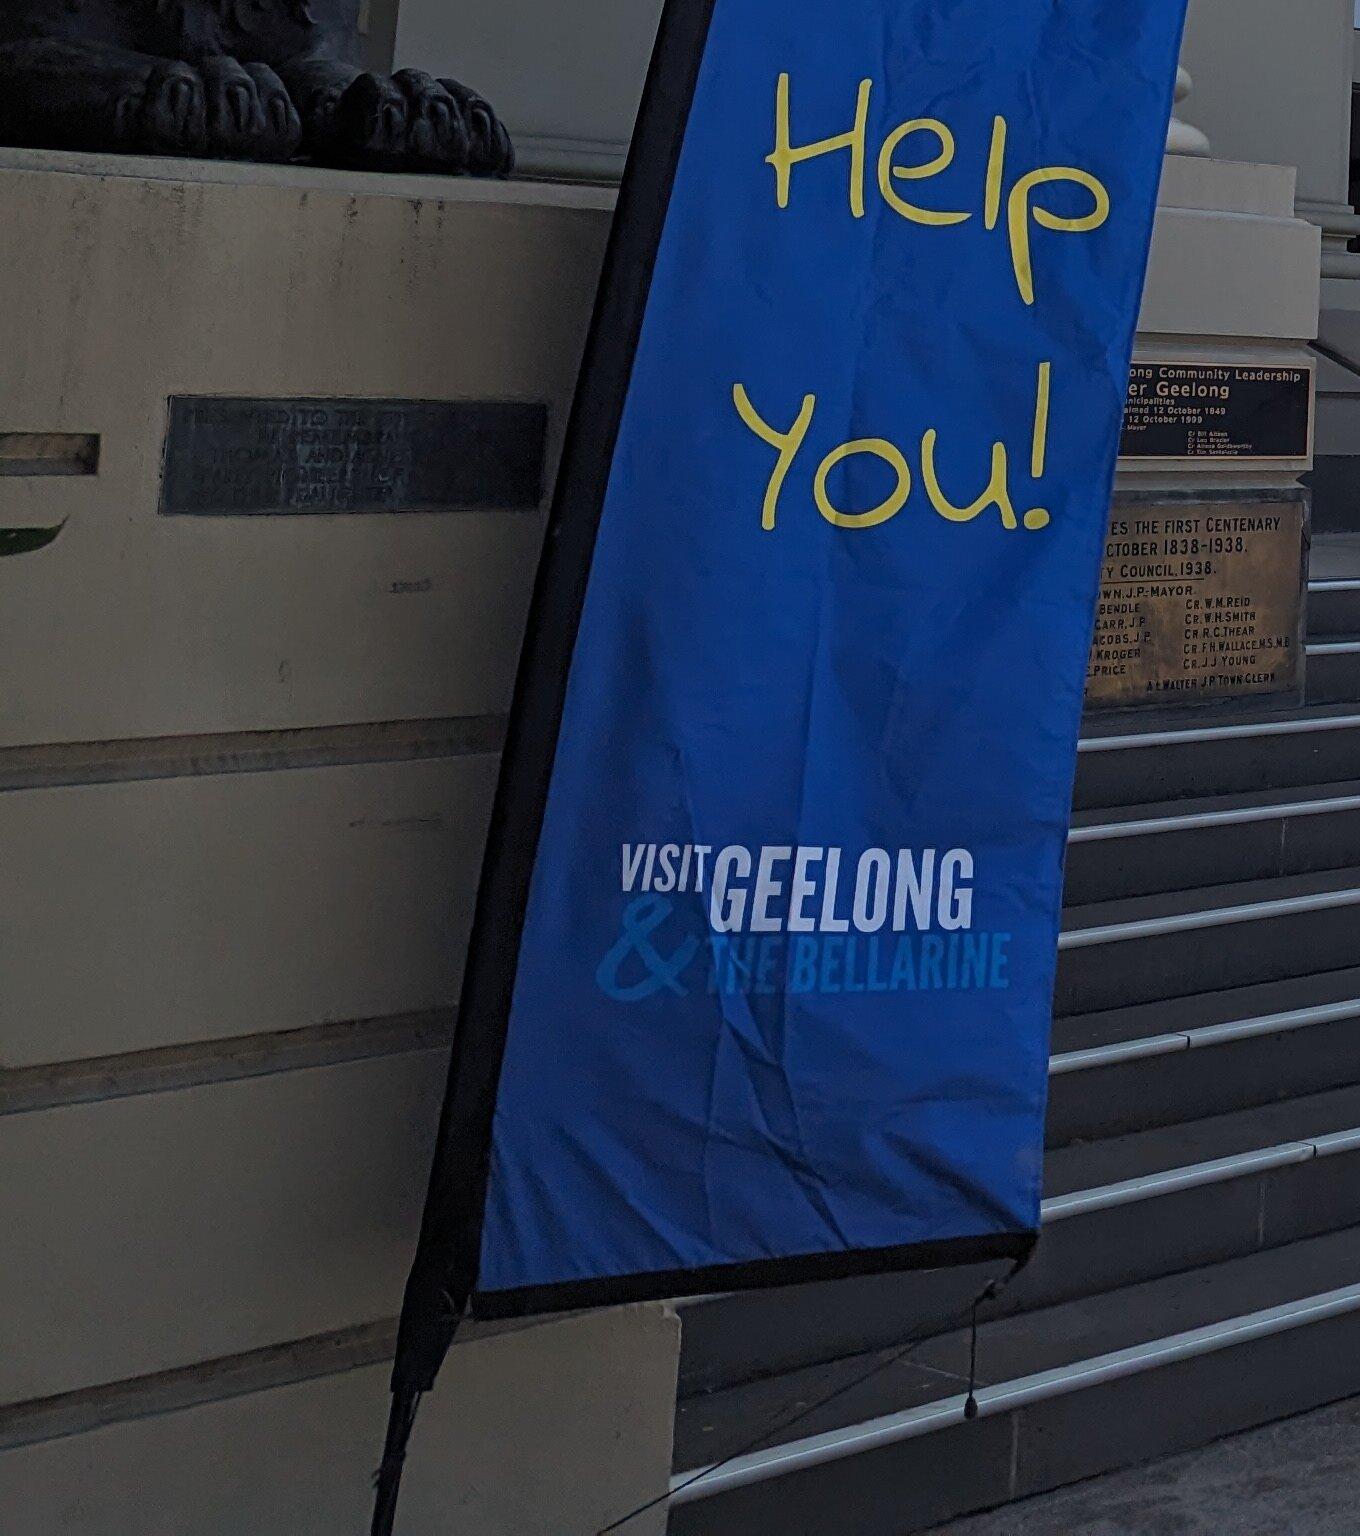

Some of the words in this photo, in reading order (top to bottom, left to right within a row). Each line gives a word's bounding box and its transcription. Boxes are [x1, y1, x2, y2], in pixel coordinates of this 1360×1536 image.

[764, 71, 1110, 306] Help
[1159, 368, 1230, 381] Community
[1235, 369, 1301, 383] Leadership
[1156, 382, 1230, 399] Geelong
[1129, 416, 1139, 424] 12
[1143, 416, 1177, 424] October
[1153, 407, 1165, 415] 12
[1167, 407, 1202, 415] October
[732, 361, 1051, 531] You!
[1135, 519, 1158, 535] THE
[1164, 518, 1200, 534] FIRST
[1206, 516, 1281, 533] CENTENARY
[1106, 541, 1158, 558] CTOBER
[621, 842, 712, 894] VISIT
[708, 845, 975, 933] GEELONG
[595, 892, 700, 1003] &
[707, 935, 784, 996] THE
[787, 931, 1012, 995] BELLARINE
